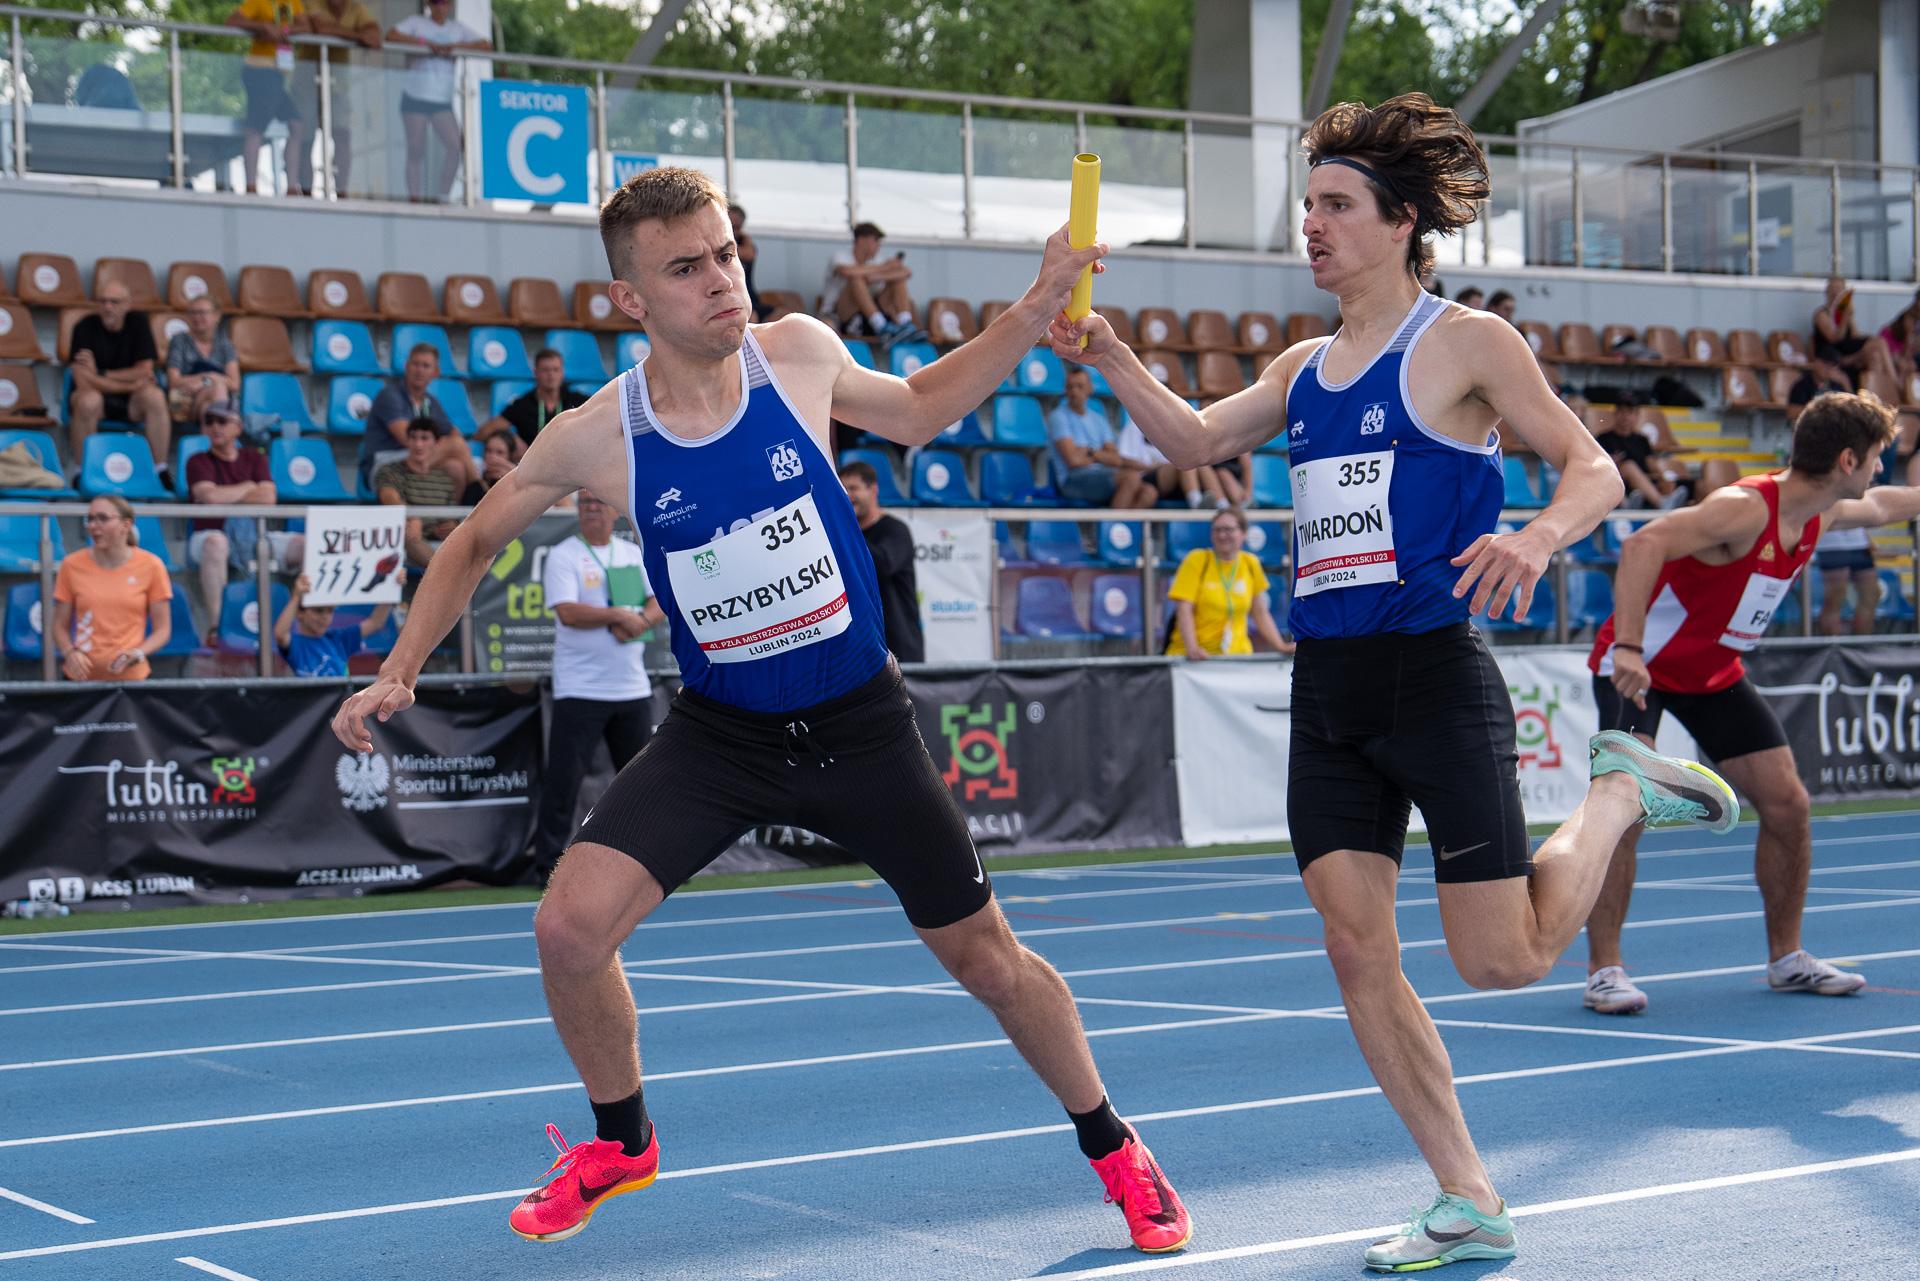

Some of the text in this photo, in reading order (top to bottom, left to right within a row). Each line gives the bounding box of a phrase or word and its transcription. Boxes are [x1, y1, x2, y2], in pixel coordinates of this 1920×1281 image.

[499, 90, 568, 112] SEKTOR
[507, 115, 566, 196] C
[1338, 460, 1381, 487] 355
[761, 508, 811, 551] 351
[1299, 503, 1383, 548] TWARDOŃ
[1345, 555, 1372, 565] POLSKI
[1373, 553, 1388, 562] U23
[690, 555, 834, 626] PRZYBYLSKI
[1313, 571, 1357, 587] LUBLIN 2024
[709, 598, 845, 650] 41. PZLA MISTRZOSTWA POLSKI U23
[749, 627, 822, 656] LUBLIN 2024
[392, 754, 496, 772] Ministerstwo
[1820, 763, 1896, 785] MIASTO
[394, 771, 528, 796] Sportu i Turystyki
[106, 807, 257, 823] MIASTO INSPIRACJI
[738, 825, 832, 846] MIAS
[91, 879, 133, 897] ACSS
[136, 876, 195, 895] LUBLIN
